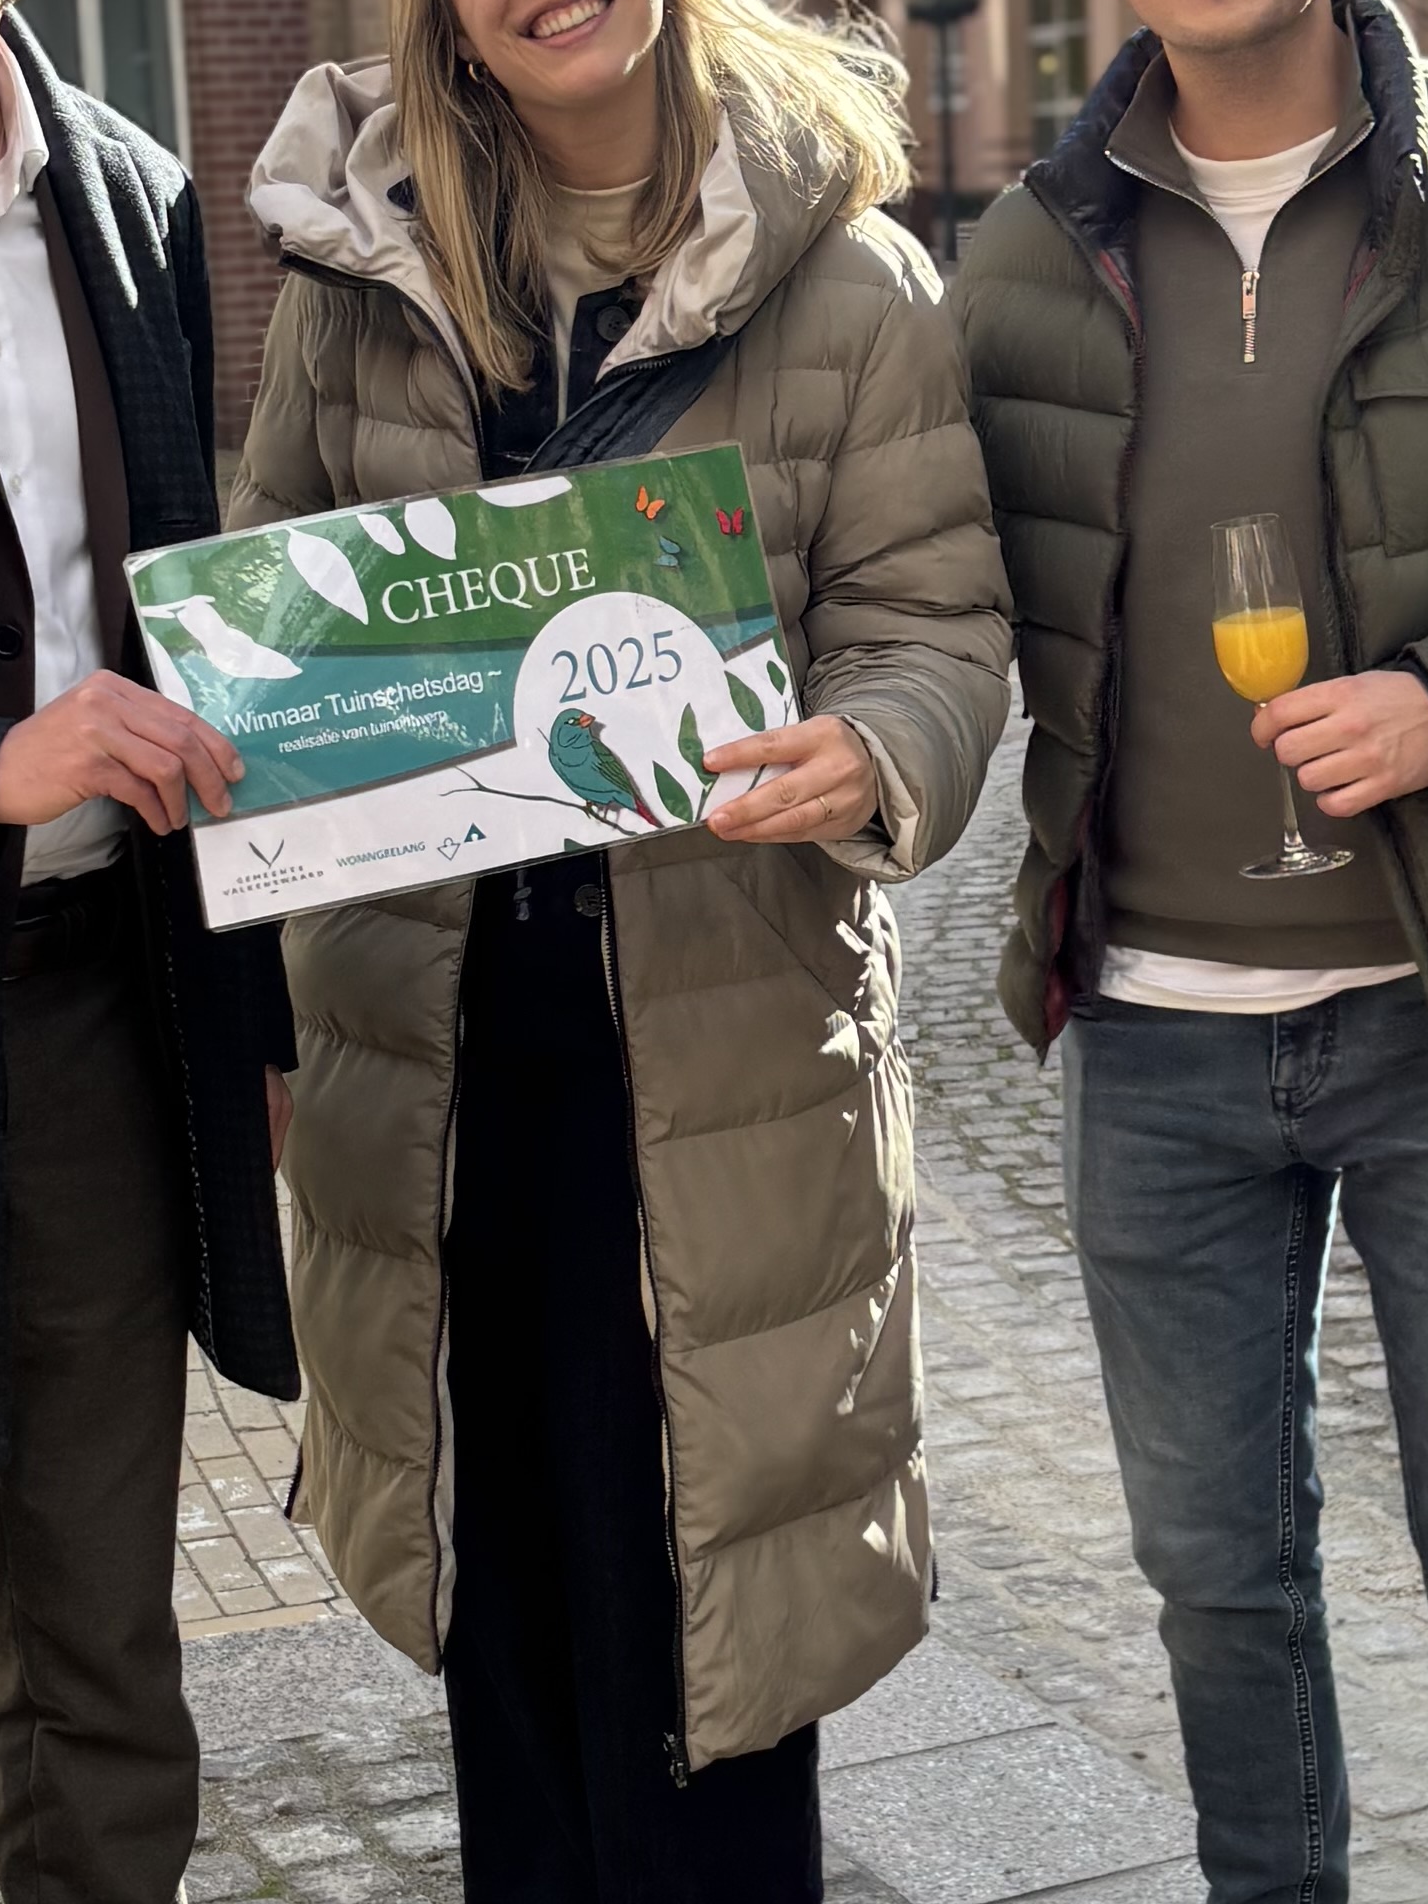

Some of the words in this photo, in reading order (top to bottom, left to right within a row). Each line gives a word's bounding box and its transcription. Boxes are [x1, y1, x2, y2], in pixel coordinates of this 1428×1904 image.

[381, 548, 597, 625] CHEQUE
[550, 629, 683, 704] 2025
[223, 700, 322, 737] Winnaar
[324, 669, 485, 717] Tuinschetsdag
[278, 728, 341, 754] realisatie
[341, 722, 369, 742] van
[222, 870, 325, 896] VALKENSWAARD
[235, 865, 304, 884] GEMEENTE
